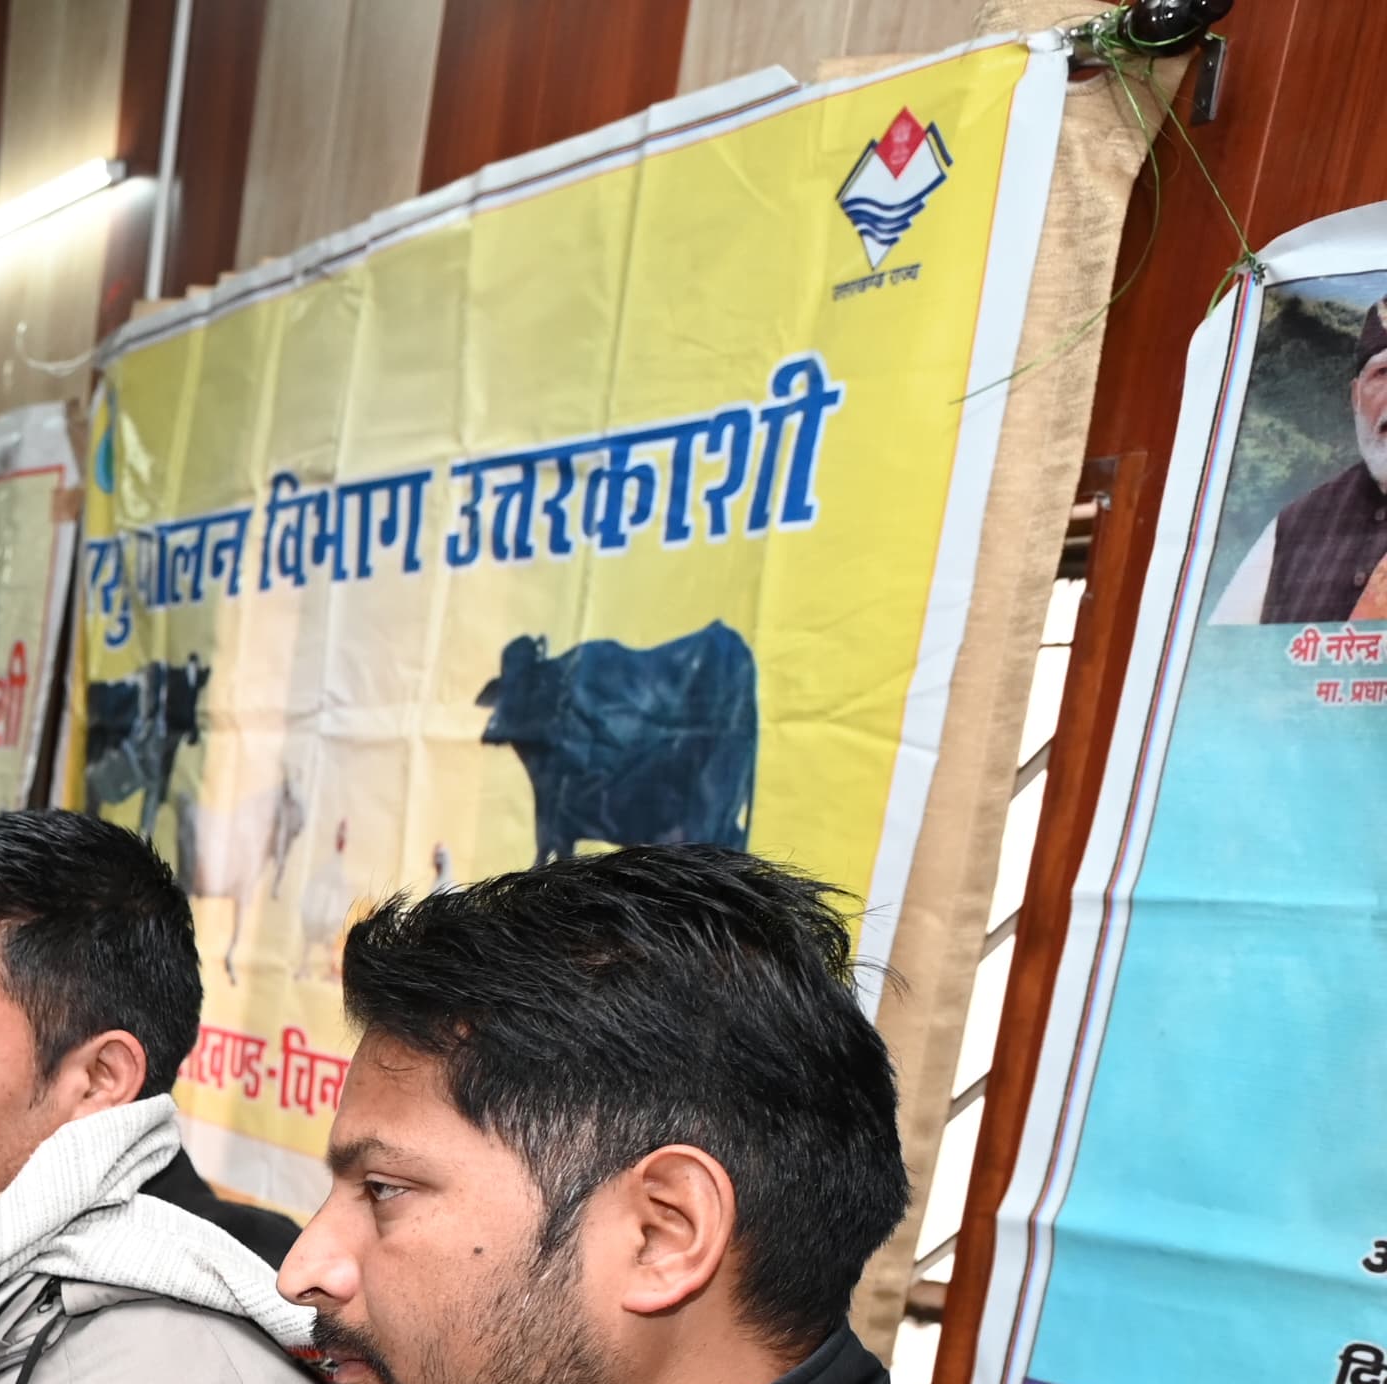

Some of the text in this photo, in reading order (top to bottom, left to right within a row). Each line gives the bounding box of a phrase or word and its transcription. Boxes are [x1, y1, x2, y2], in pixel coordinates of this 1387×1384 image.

[259, 471, 434, 592] विभाग
[445, 356, 841, 568] उत्तरकाशी
[1290, 627, 1383, 662] श्री नरेन्द्र
[1350, 680, 1387, 702] प्रधा
